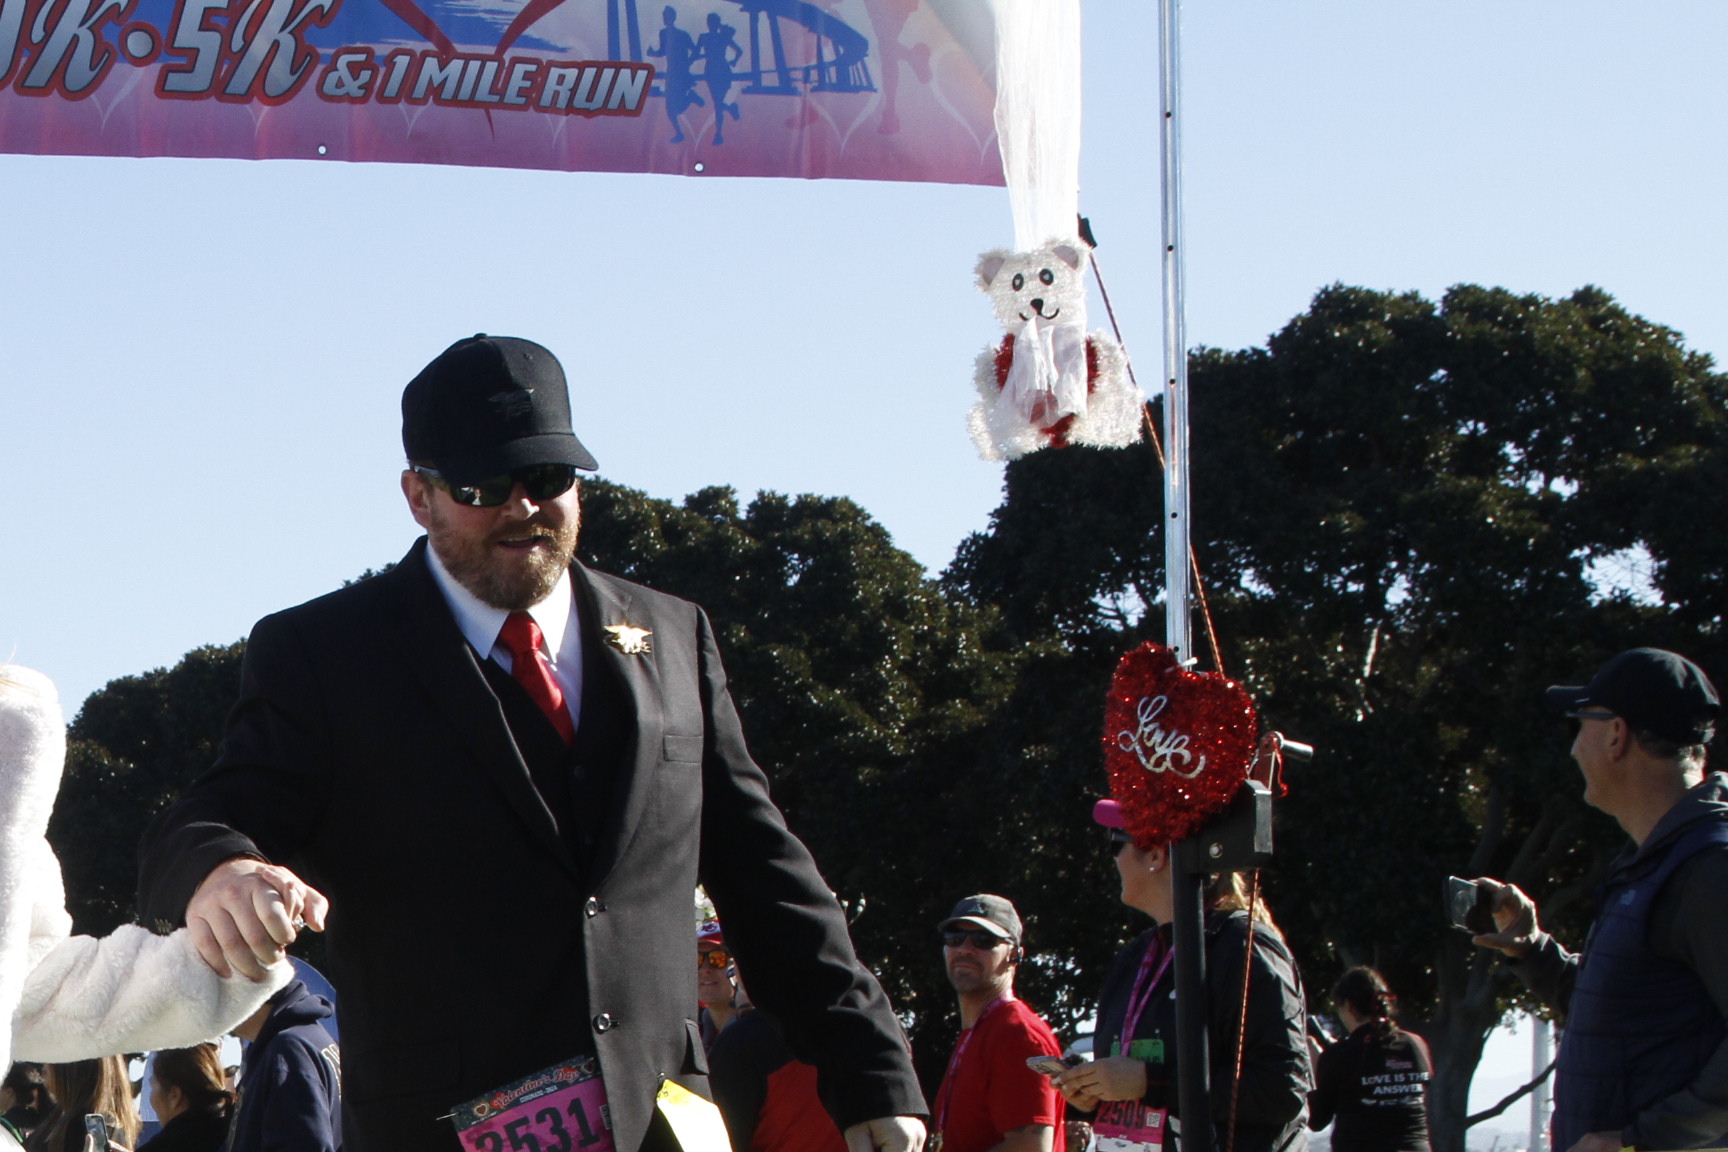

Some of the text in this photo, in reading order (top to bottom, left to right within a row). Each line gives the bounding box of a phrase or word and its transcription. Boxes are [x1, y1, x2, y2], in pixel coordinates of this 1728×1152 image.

[322, 53, 372, 98] &
[412, 56, 537, 105] MILE
[538, 66, 648, 112] RUN
[1117, 694, 1207, 780] Love
[1362, 1071, 1430, 1085] LOVE IS THE
